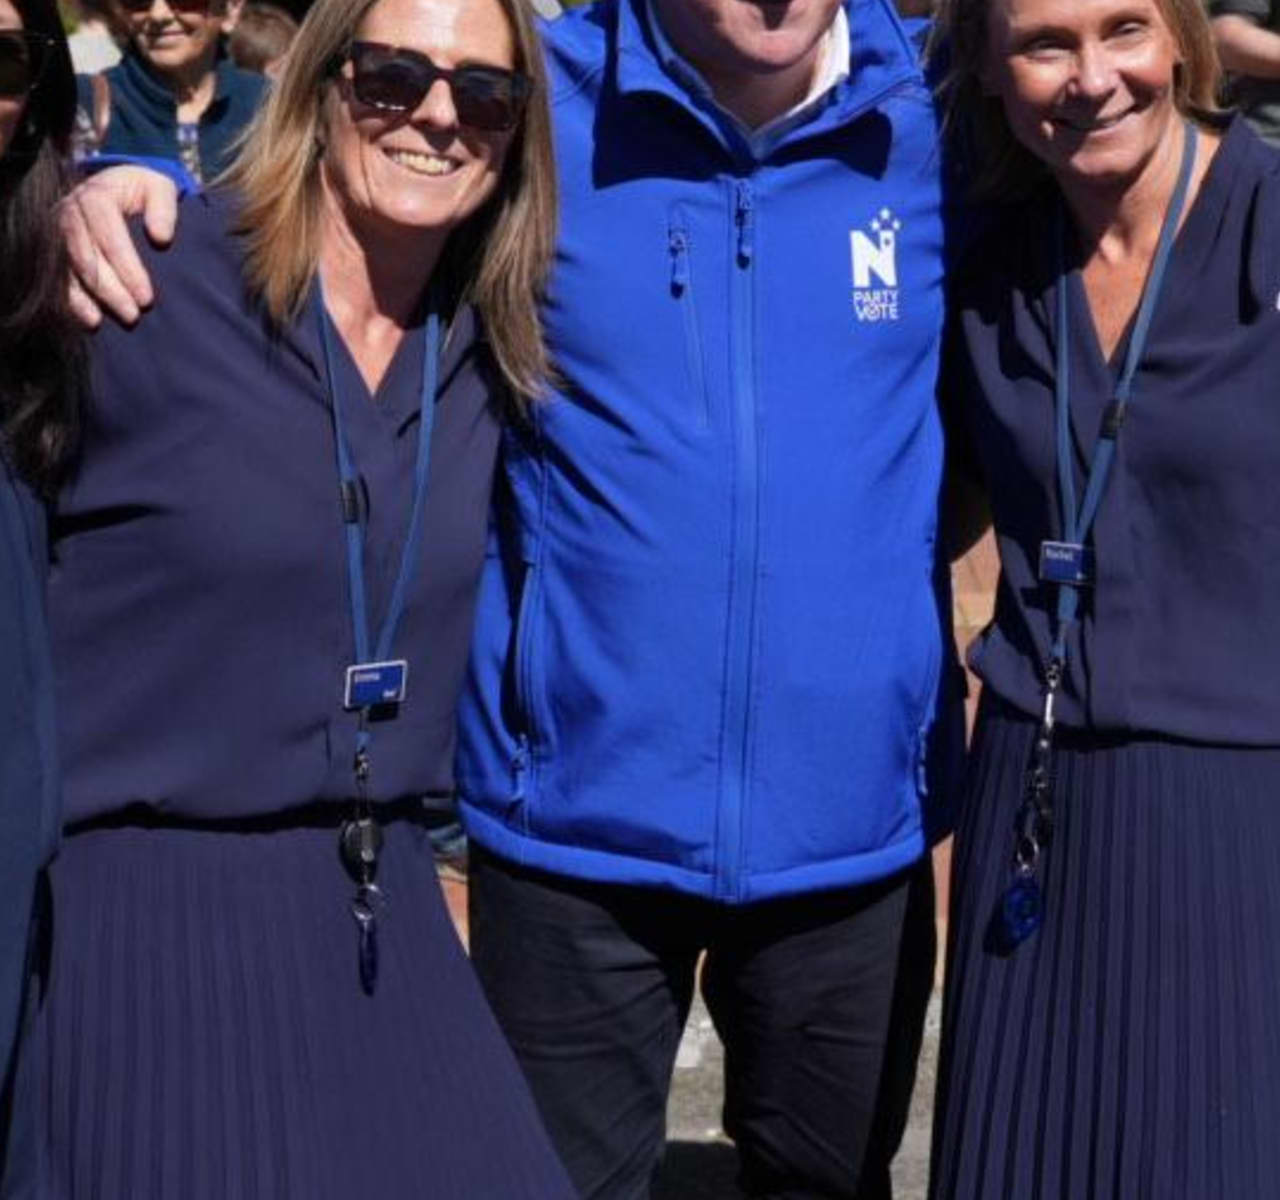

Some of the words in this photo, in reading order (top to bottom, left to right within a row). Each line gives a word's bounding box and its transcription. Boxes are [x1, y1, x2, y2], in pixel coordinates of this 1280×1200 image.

[849, 229, 898, 288] N
[852, 289, 899, 304] PARTY
[854, 303, 899, 321] VOTE
